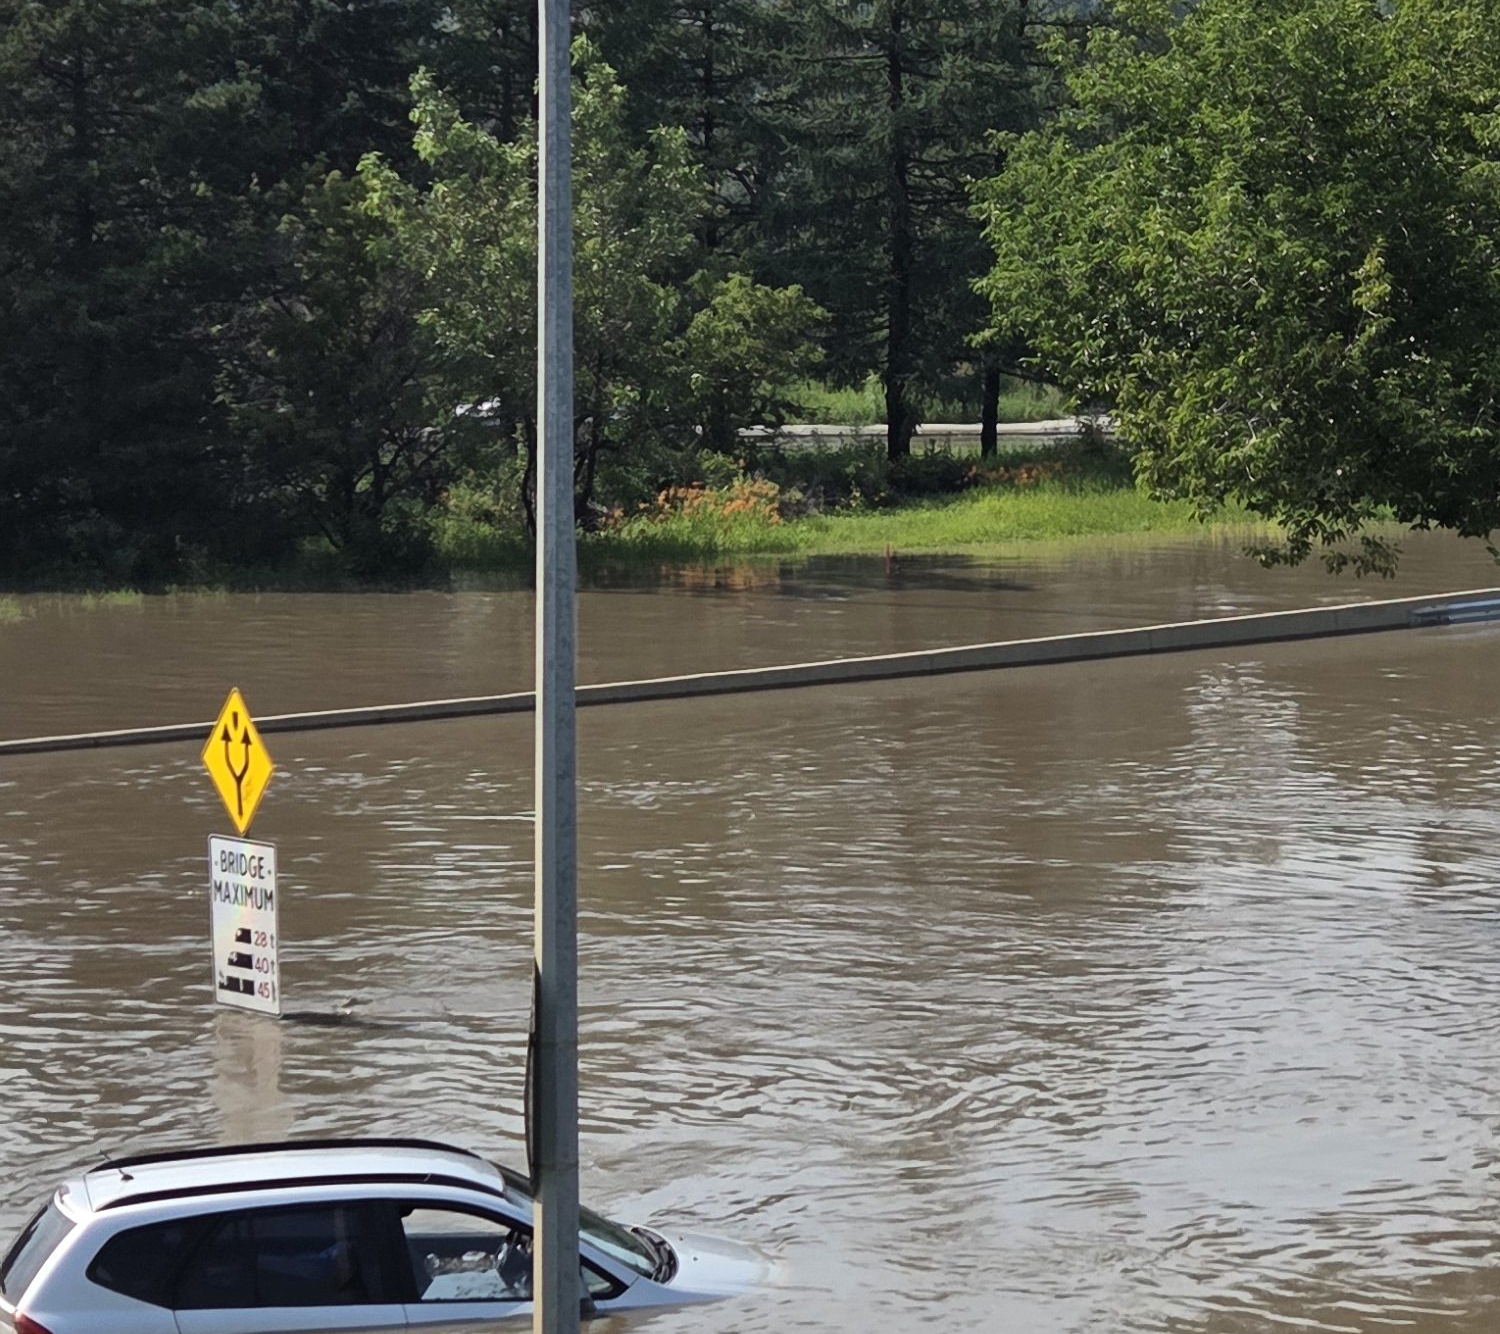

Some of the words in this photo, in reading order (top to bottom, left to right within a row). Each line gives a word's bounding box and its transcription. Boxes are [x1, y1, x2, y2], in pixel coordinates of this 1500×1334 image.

[220, 849, 265, 880] BRIDGE
[213, 879, 274, 912] MAXIMUM
[254, 930, 268, 948] 28
[254, 957, 270, 974] 40
[257, 981, 270, 999] 45
